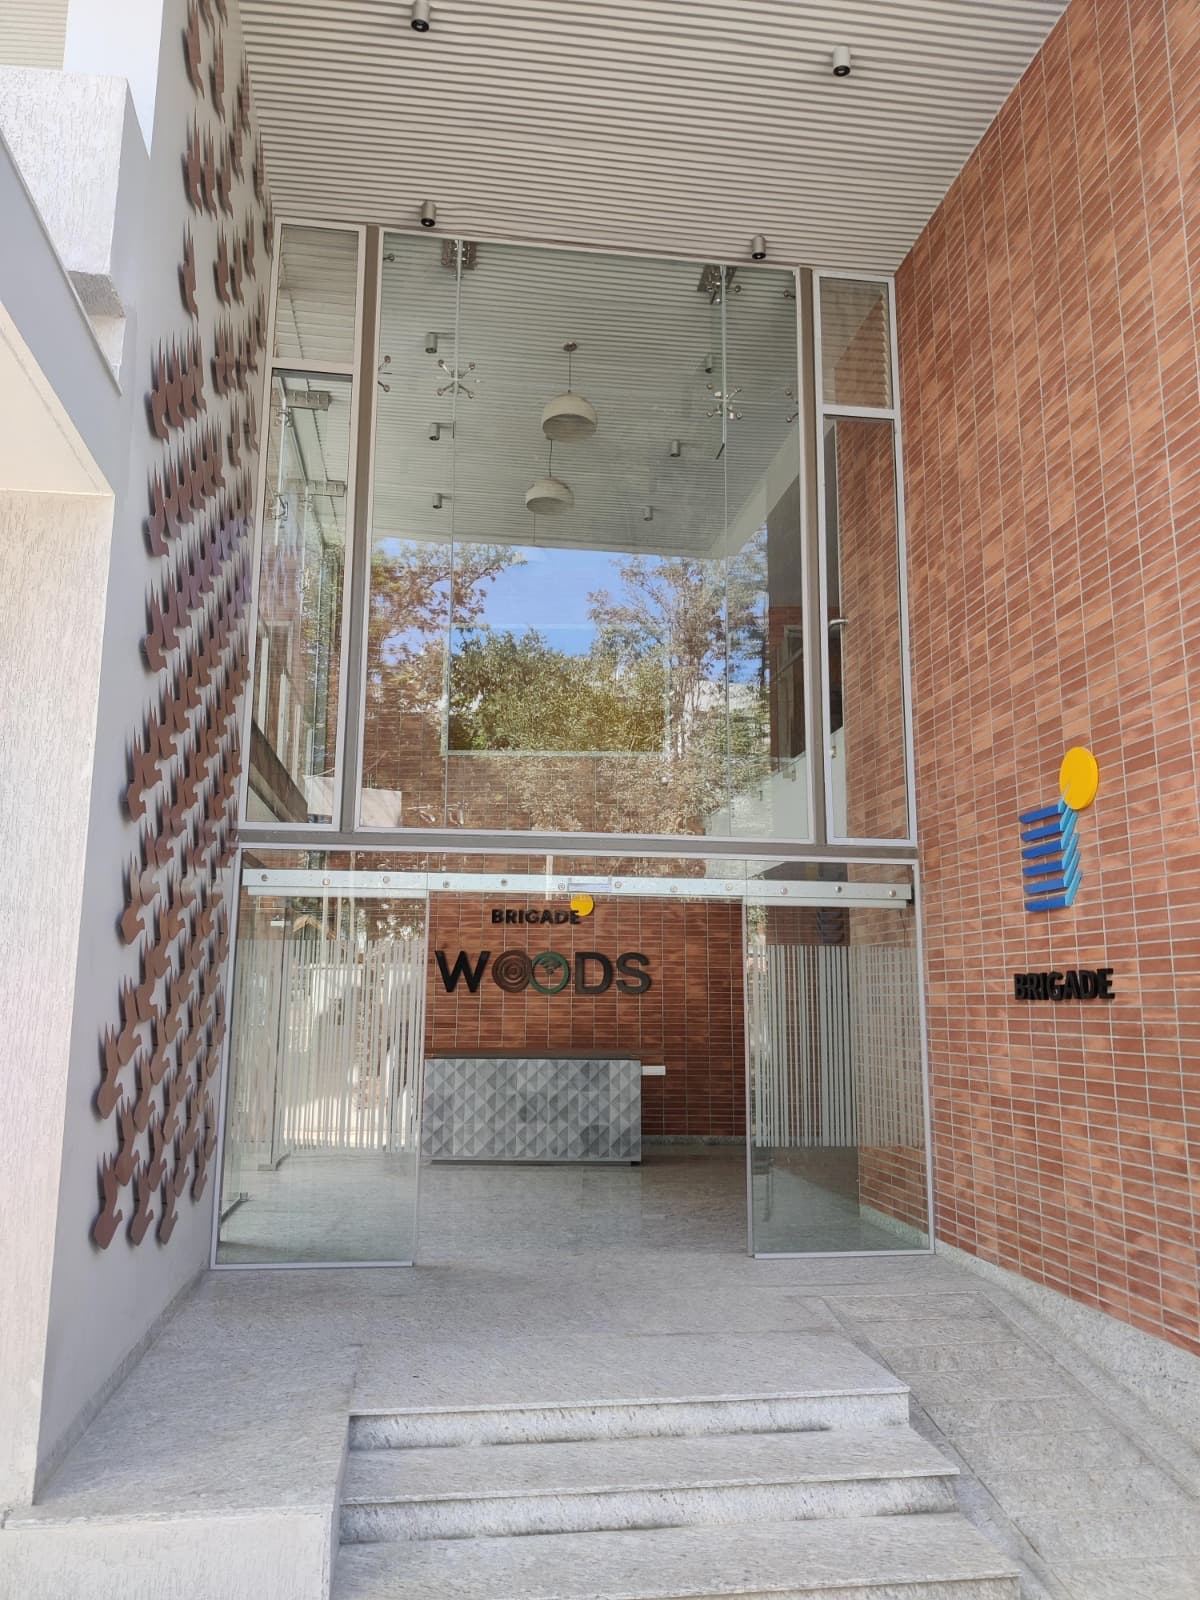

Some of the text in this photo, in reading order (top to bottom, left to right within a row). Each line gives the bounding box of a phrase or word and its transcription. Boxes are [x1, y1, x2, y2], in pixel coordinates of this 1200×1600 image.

[491, 908, 580, 925] BRIGADE
[434, 949, 650, 994] WOODS
[1013, 968, 1115, 1001] BRIGADE
